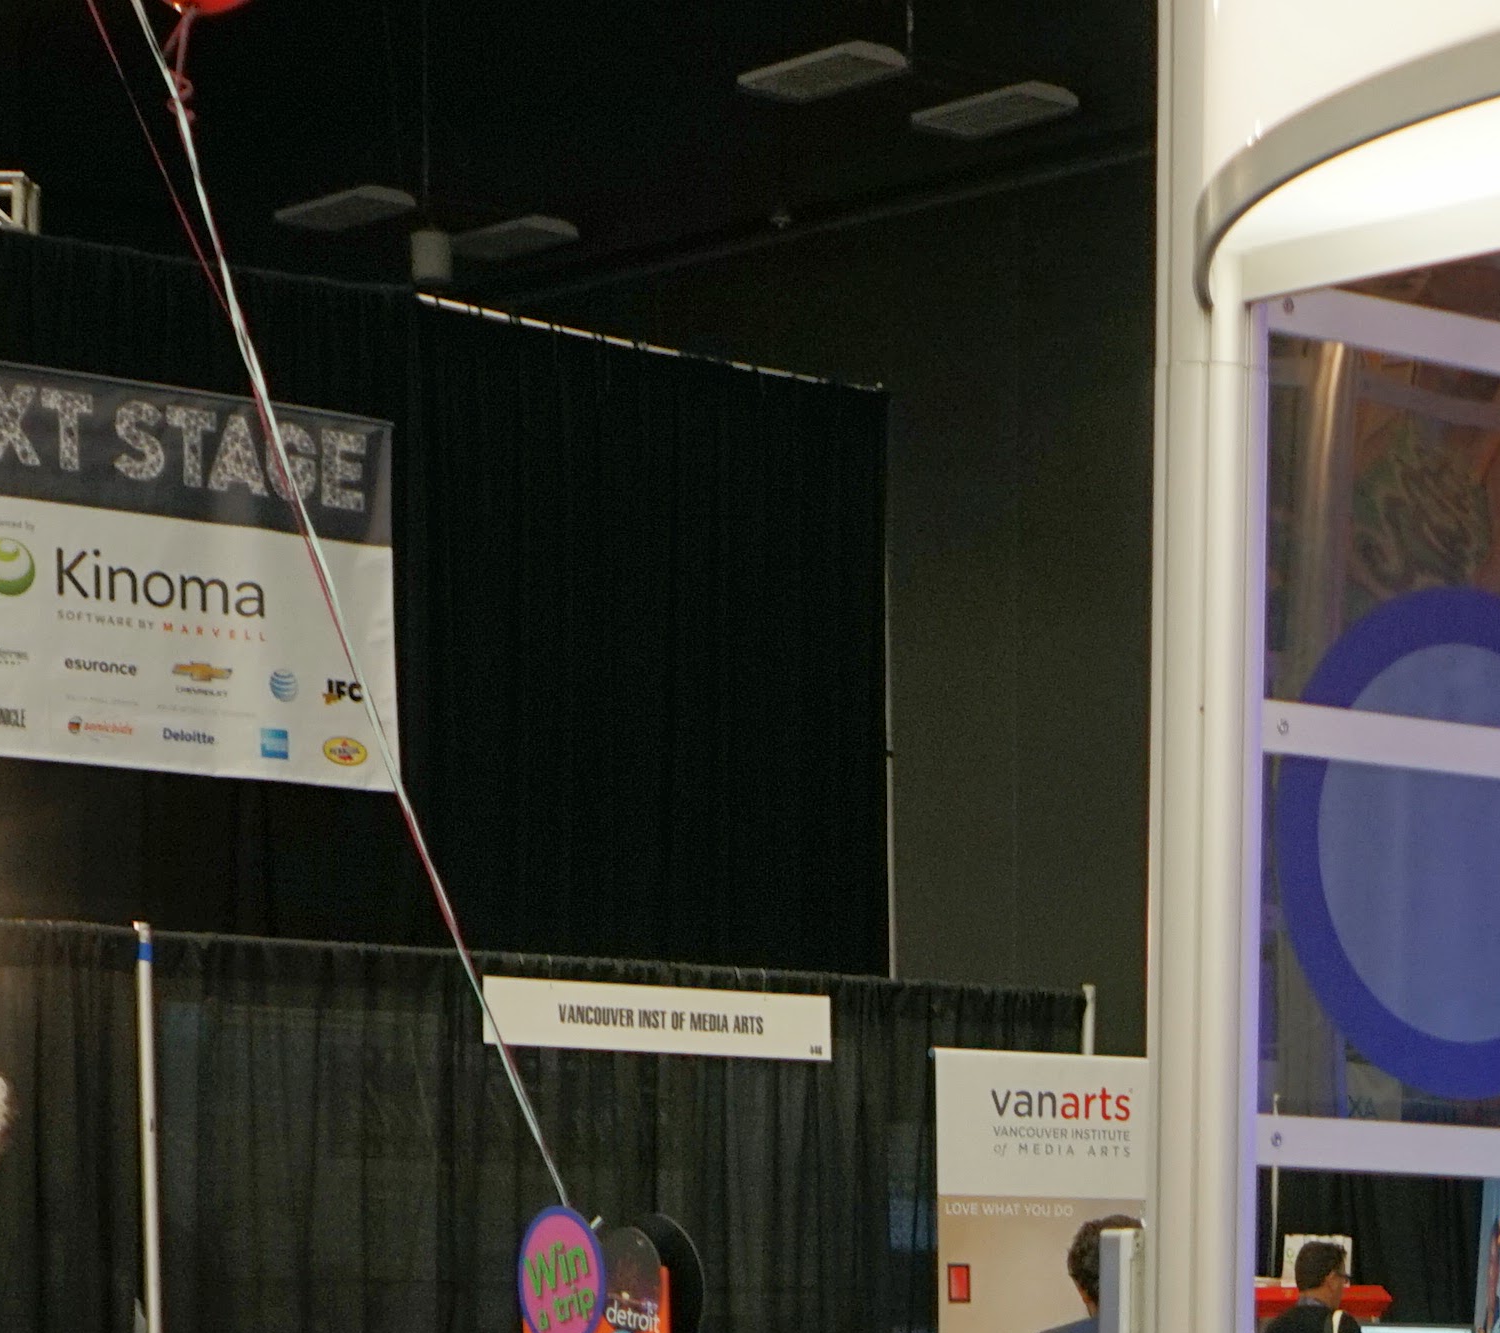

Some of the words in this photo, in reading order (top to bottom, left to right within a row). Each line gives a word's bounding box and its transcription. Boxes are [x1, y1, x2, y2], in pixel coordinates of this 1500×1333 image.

[113, 400, 367, 512] STAGE
[56, 547, 266, 618] Kinoma
[56, 609, 133, 628] SOFTWARE
[137, 618, 155, 631] BY
[162, 622, 267, 643] MARVELL
[64, 656, 138, 677] esurance
[558, 1003, 634, 1029] VANCOUVER
[638, 1010, 667, 1031] INST
[671, 1012, 687, 1031] OF
[690, 1014, 729, 1034] MEDIA
[733, 1015, 765, 1036] ARTS
[991, 1087, 1131, 1122] vanarts
[992, 1125, 1068, 1141] VANCOUVER
[1071, 1130, 1131, 1142] INSTITUTE
[993, 1144, 1008, 1158] of
[1018, 1144, 1075, 1156] MEDIA
[1087, 1146, 1132, 1158] ARTS
[946, 1203, 979, 1215] LOVE
[981, 1203, 1021, 1217] WHAT
[1025, 1204, 1051, 1217] YOU
[1055, 1206, 1075, 1217] DO
[523, 1241, 589, 1298] Win
[539, 1310, 549, 1331] a
[553, 1284, 595, 1323] trip
